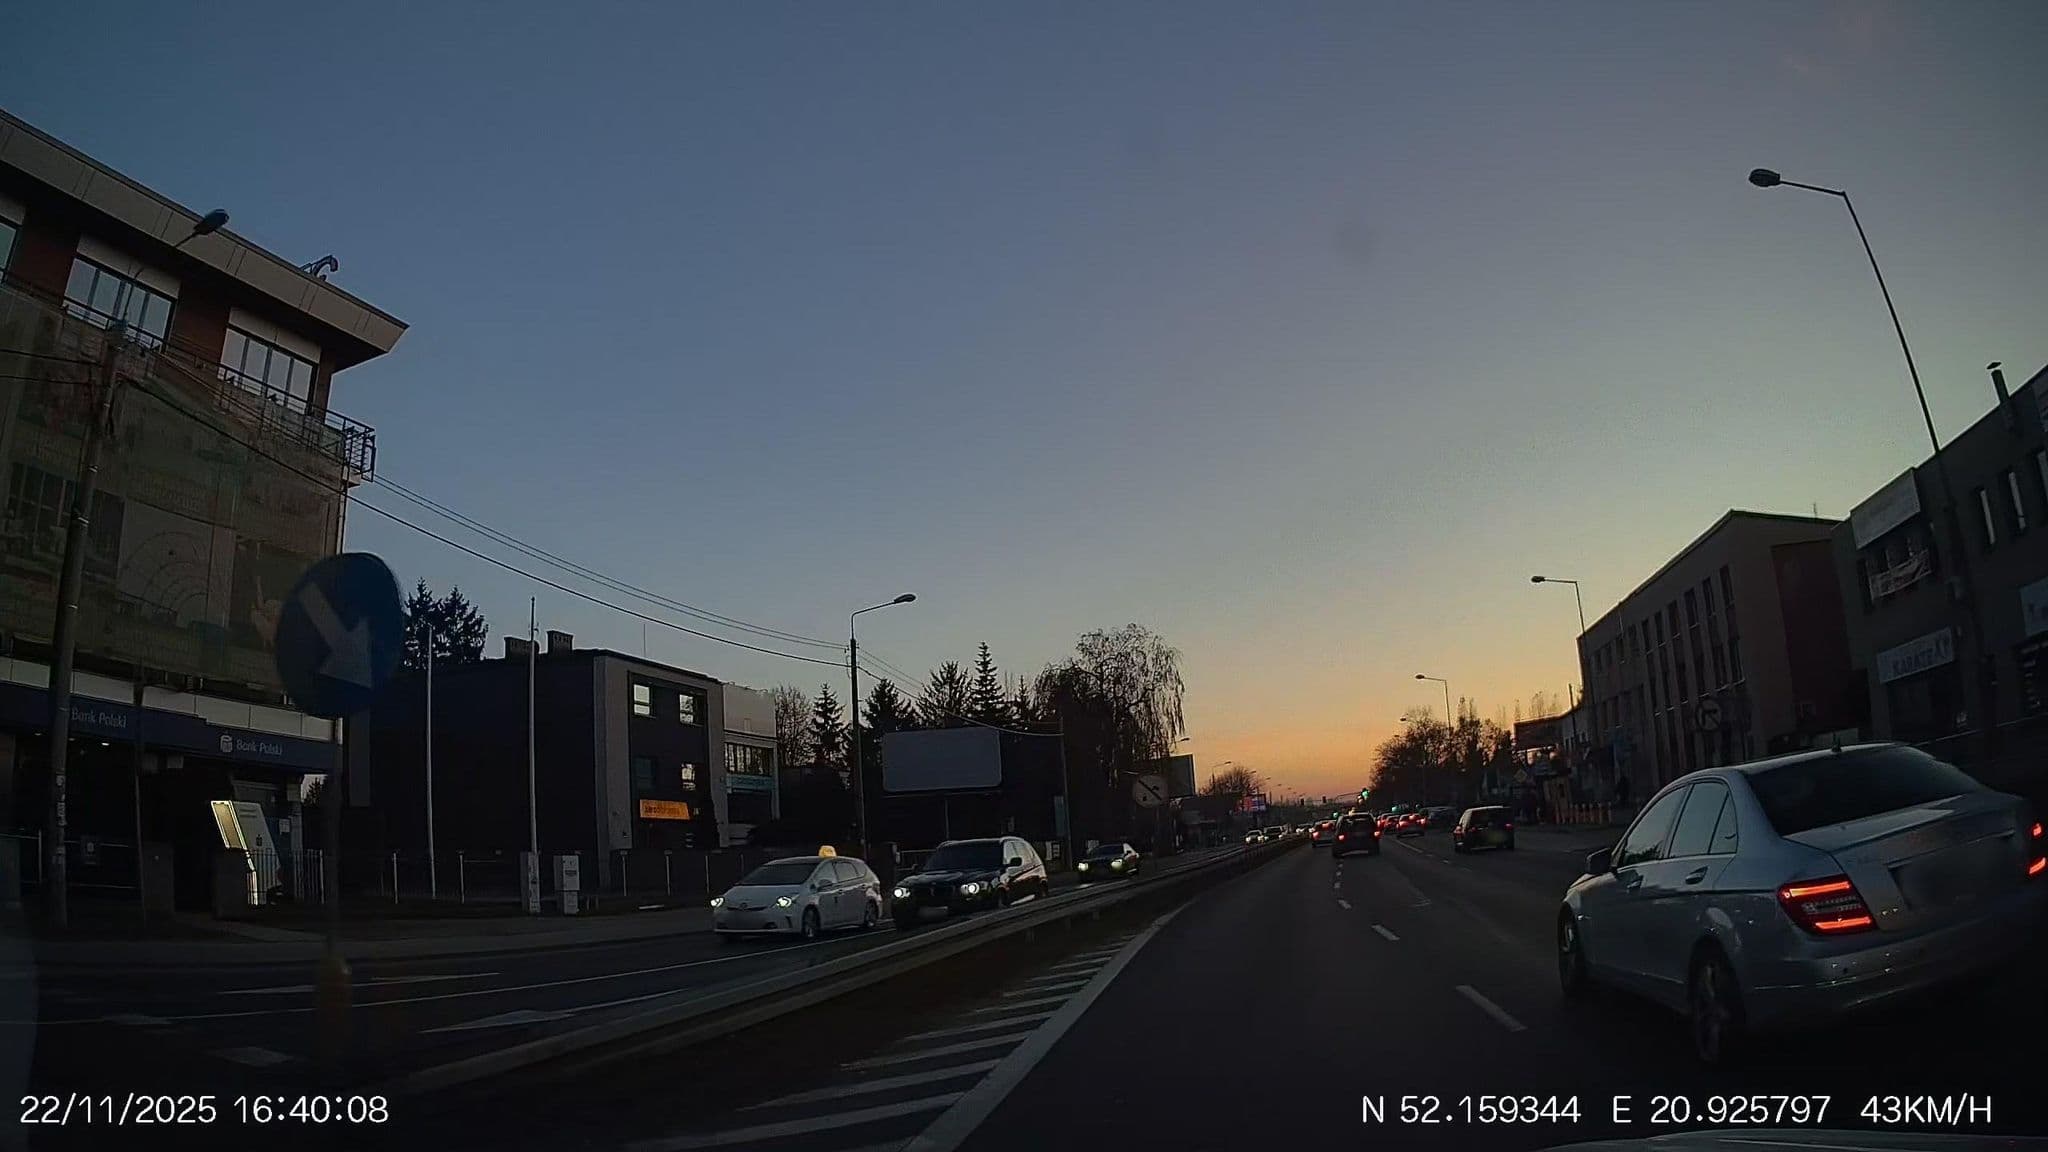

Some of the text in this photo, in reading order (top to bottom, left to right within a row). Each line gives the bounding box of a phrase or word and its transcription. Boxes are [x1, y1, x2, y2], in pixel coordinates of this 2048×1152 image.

[71, 706, 127, 729] Bank Polski
[236, 738, 257, 752] Bank
